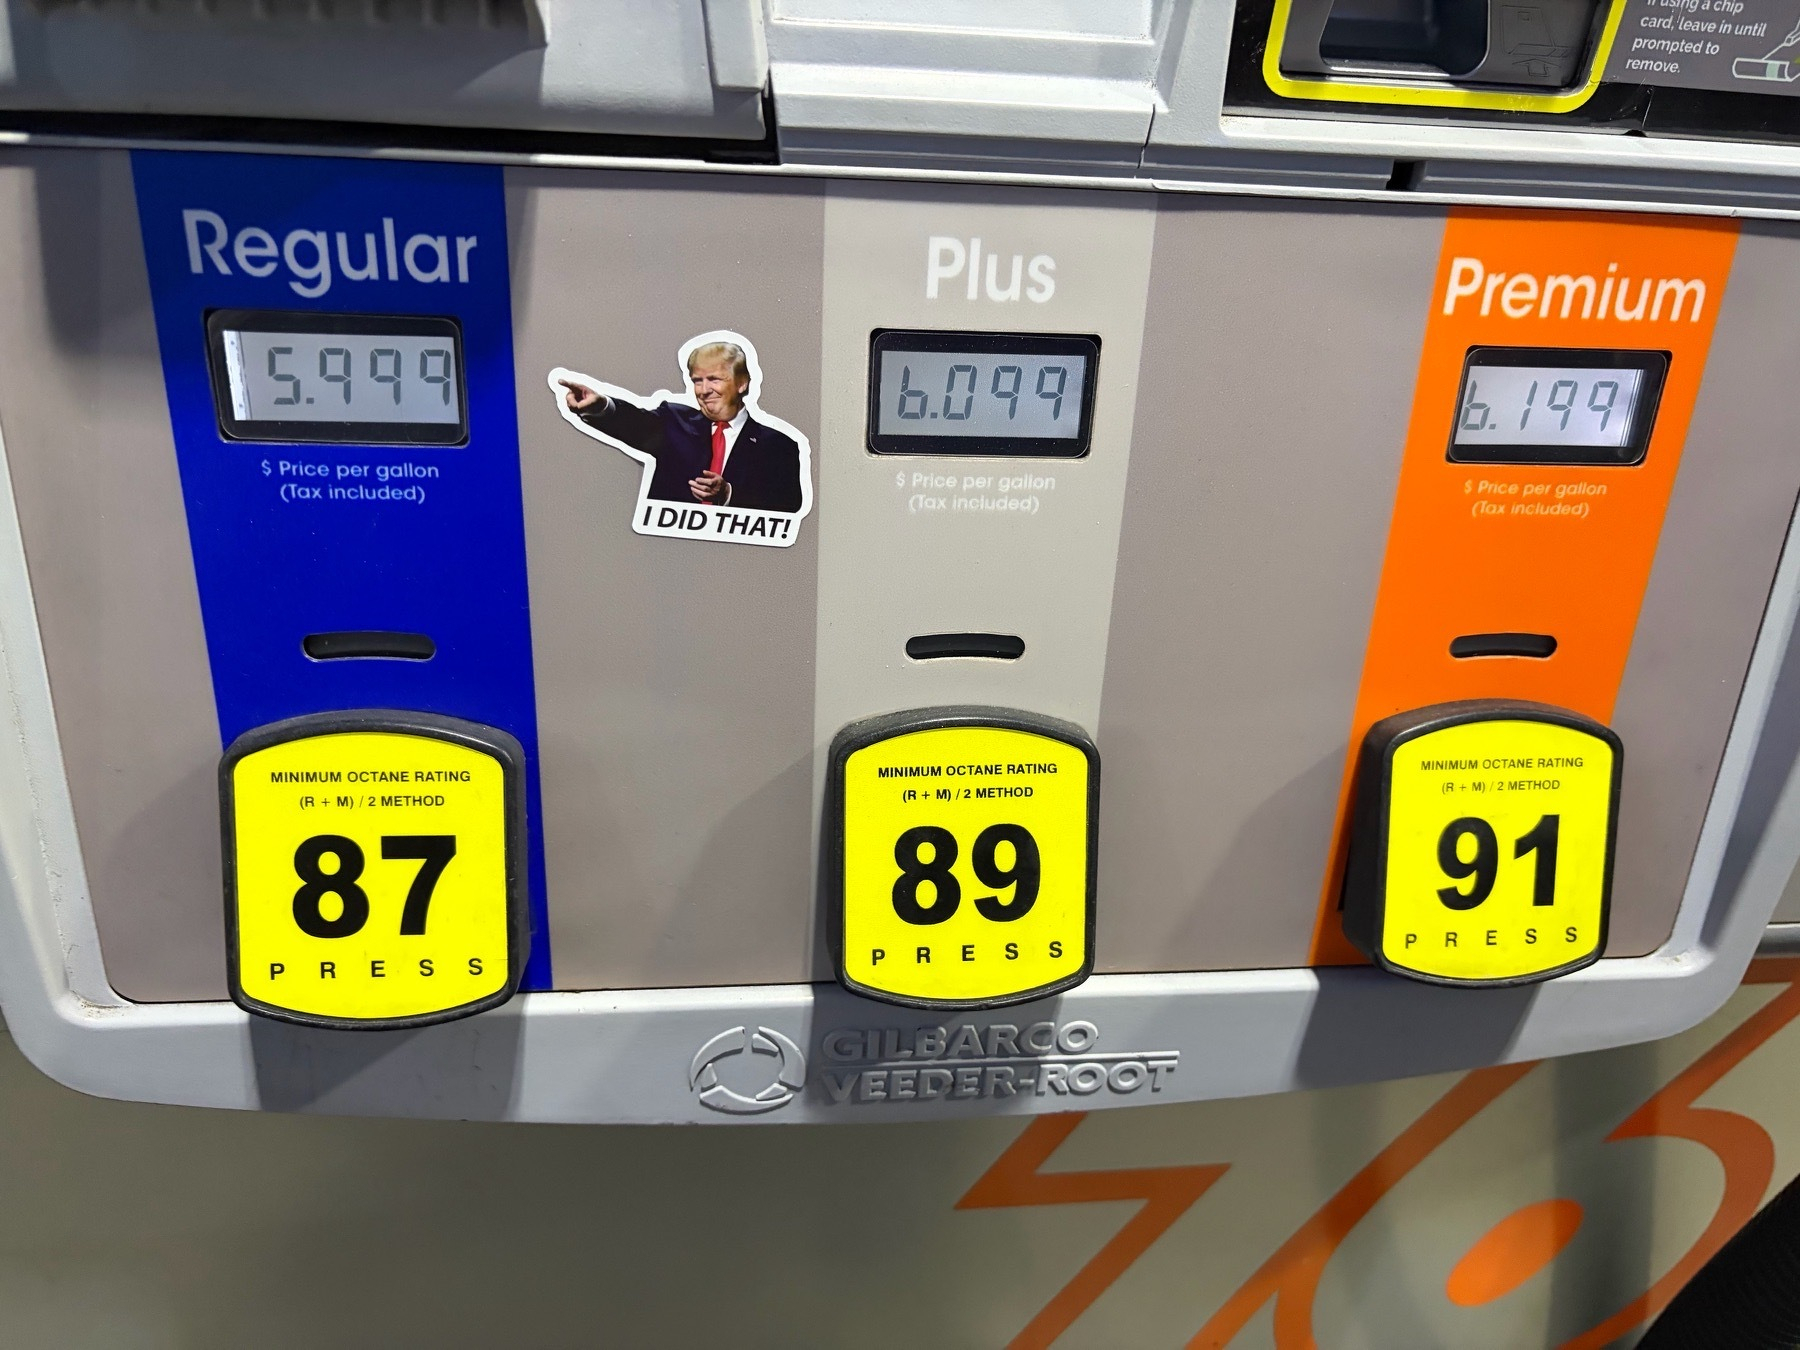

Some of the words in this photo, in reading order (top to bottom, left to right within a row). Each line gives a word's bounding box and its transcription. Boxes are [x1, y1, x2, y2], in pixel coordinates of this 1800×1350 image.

[1701, 1, 1710, 10] a
[1714, 0, 1744, 16] chip
[1640, 16, 1674, 32] card,
[1678, 17, 1717, 32] leave
[1718, 20, 1732, 34] in
[1734, 22, 1767, 37] until
[1632, 37, 1702, 54] prompted
[1705, 42, 1720, 55] to
[1626, 58, 1680, 74] remove.
[182, 208, 477, 298] Regular
[926, 236, 1057, 304] Plus
[1442, 256, 1706, 322] Premium
[267, 346, 451, 406] 5.999
[897, 365, 1067, 421] 6.099
[1460, 379, 1619, 432] 6.199
[262, 459, 272, 476] $
[279, 460, 329, 477] Price
[337, 464, 370, 480] per
[376, 462, 440, 482] gallon
[895, 470, 906, 489] $
[912, 472, 958, 489] Price
[962, 475, 994, 492] per
[998, 473, 1056, 493] gallon
[280, 483, 322, 503] (Tax
[328, 484, 426, 505] included)
[1464, 479, 1472, 495] $
[1478, 480, 1519, 495] Price
[1523, 483, 1552, 498] per
[1555, 481, 1608, 499] gallon
[908, 493, 946, 515] (Tax
[952, 494, 1040, 516] included)
[1472, 500, 1506, 518] (Tax
[1511, 501, 1590, 519] included)
[643, 506, 652, 526] I
[657, 507, 708, 531] DID
[716, 512, 792, 540] THAT!
[878, 766, 942, 778] MINIMUM
[946, 764, 1002, 776] OCTANE
[1006, 763, 1058, 775] RATING
[1420, 760, 1478, 770] MINIMUM
[1482, 758, 1533, 770] OCTANE
[1537, 757, 1584, 768] RATING
[270, 771, 342, 783] MINIMUM
[347, 771, 410, 782] OCTANE
[414, 770, 471, 782] RATING
[1442, 781, 1454, 794] (R
[1459, 783, 1468, 792] +
[1472, 781, 1486, 794] M)
[1497, 781, 1504, 792] 2
[1508, 780, 1560, 791] METHOD
[300, 796, 315, 810] (R
[322, 797, 331, 808] +
[337, 796, 354, 810] M)
[368, 796, 376, 807] 2
[381, 795, 445, 807] METHOD
[902, 789, 917, 803] (R
[922, 790, 931, 800] +
[936, 788, 952, 802] M)
[964, 788, 972, 799] 2
[976, 786, 1034, 799] METHOD
[1436, 814, 1560, 911] 91
[892, 823, 1041, 926] 89
[292, 834, 457, 939] 87
[822, 1020, 1099, 1061] GILBARCO
[819, 1060, 1178, 1104] VEEDER-ROOT
